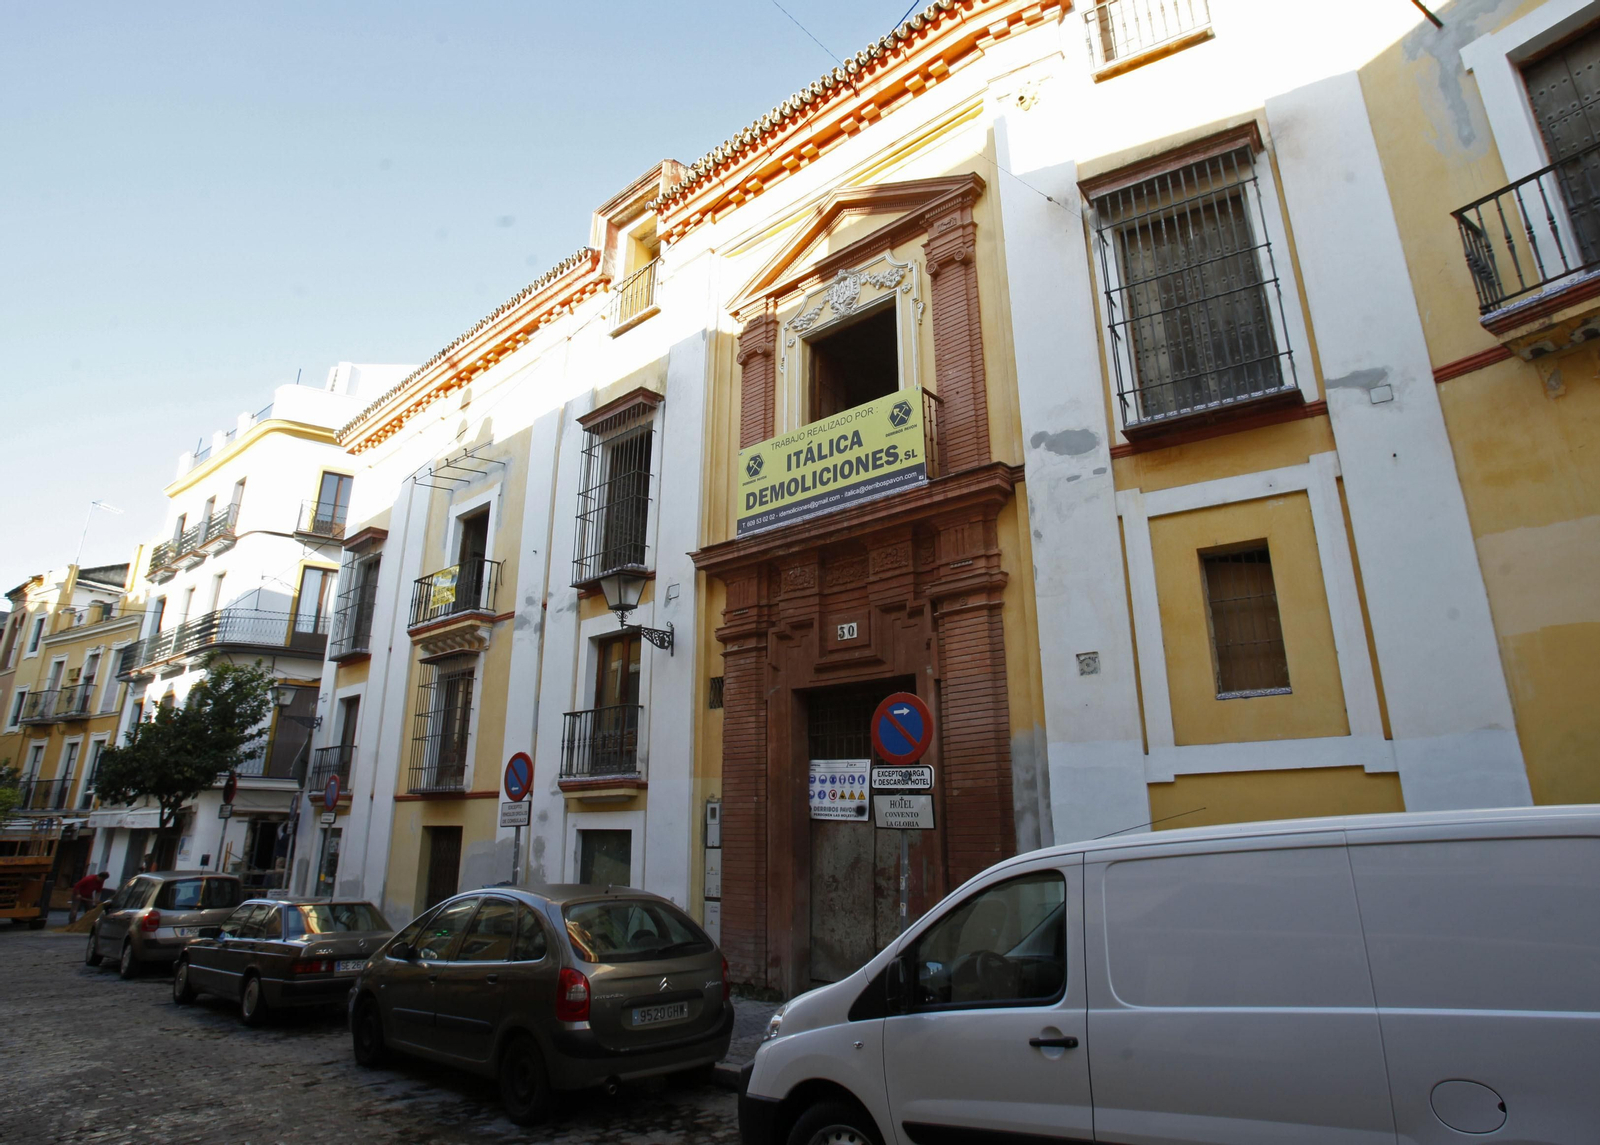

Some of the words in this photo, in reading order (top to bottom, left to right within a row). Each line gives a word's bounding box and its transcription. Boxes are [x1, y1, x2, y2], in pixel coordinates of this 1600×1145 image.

[771, 432, 805, 451] TRABAJO
[806, 414, 853, 438] REALIZADO
[854, 406, 874, 420] POR
[786, 429, 864, 472] ITÁLICA
[769, 513, 776, 521] 02
[838, 625, 855, 639] 30
[877, 770, 903, 778] EXCEPTO
[813, 805, 839, 813] DERRIBOS
[889, 798, 914, 809] HOTEL
[341, 961, 350, 970] SE
[640, 1006, 666, 1022] 9520
